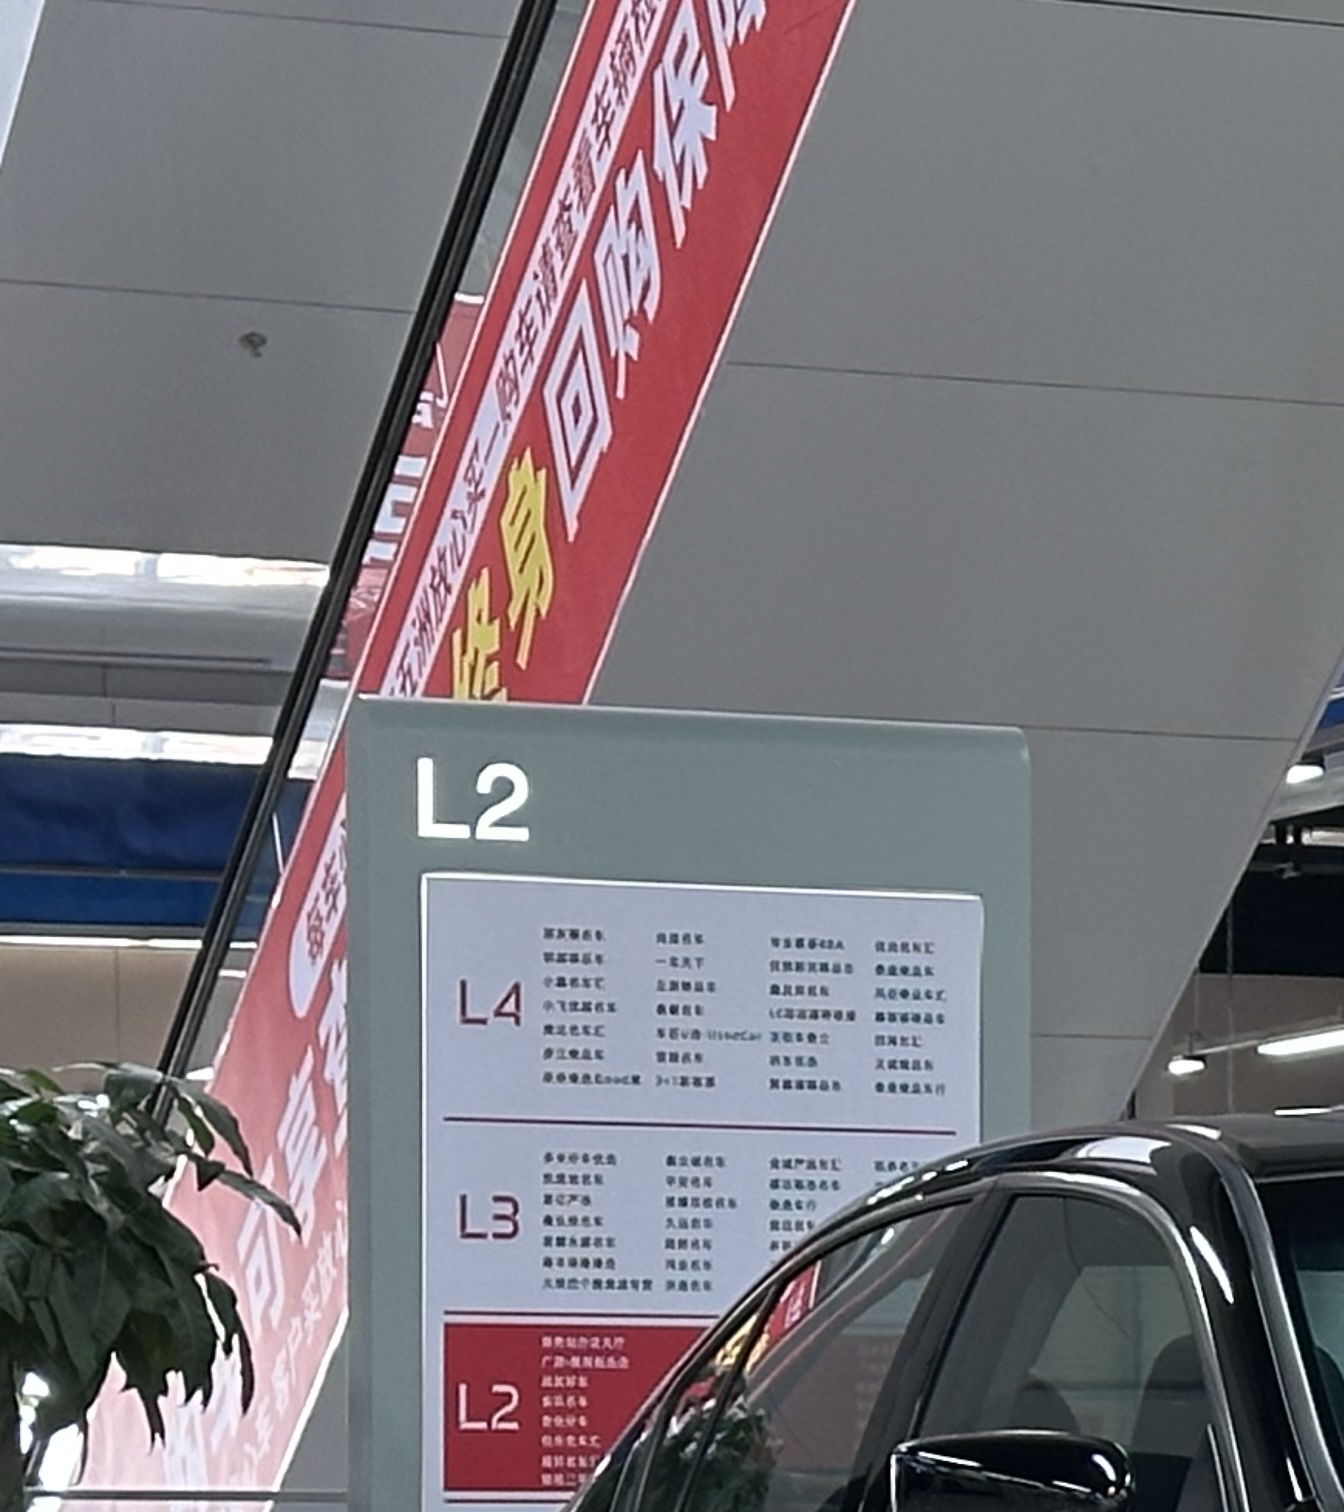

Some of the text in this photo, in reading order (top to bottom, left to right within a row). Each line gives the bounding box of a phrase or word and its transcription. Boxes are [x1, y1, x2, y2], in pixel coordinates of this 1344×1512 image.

[416, 757, 530, 841] L2
[458, 979, 522, 1026] L4
[458, 1193, 520, 1240] L3
[458, 1383, 520, 1431] L2
